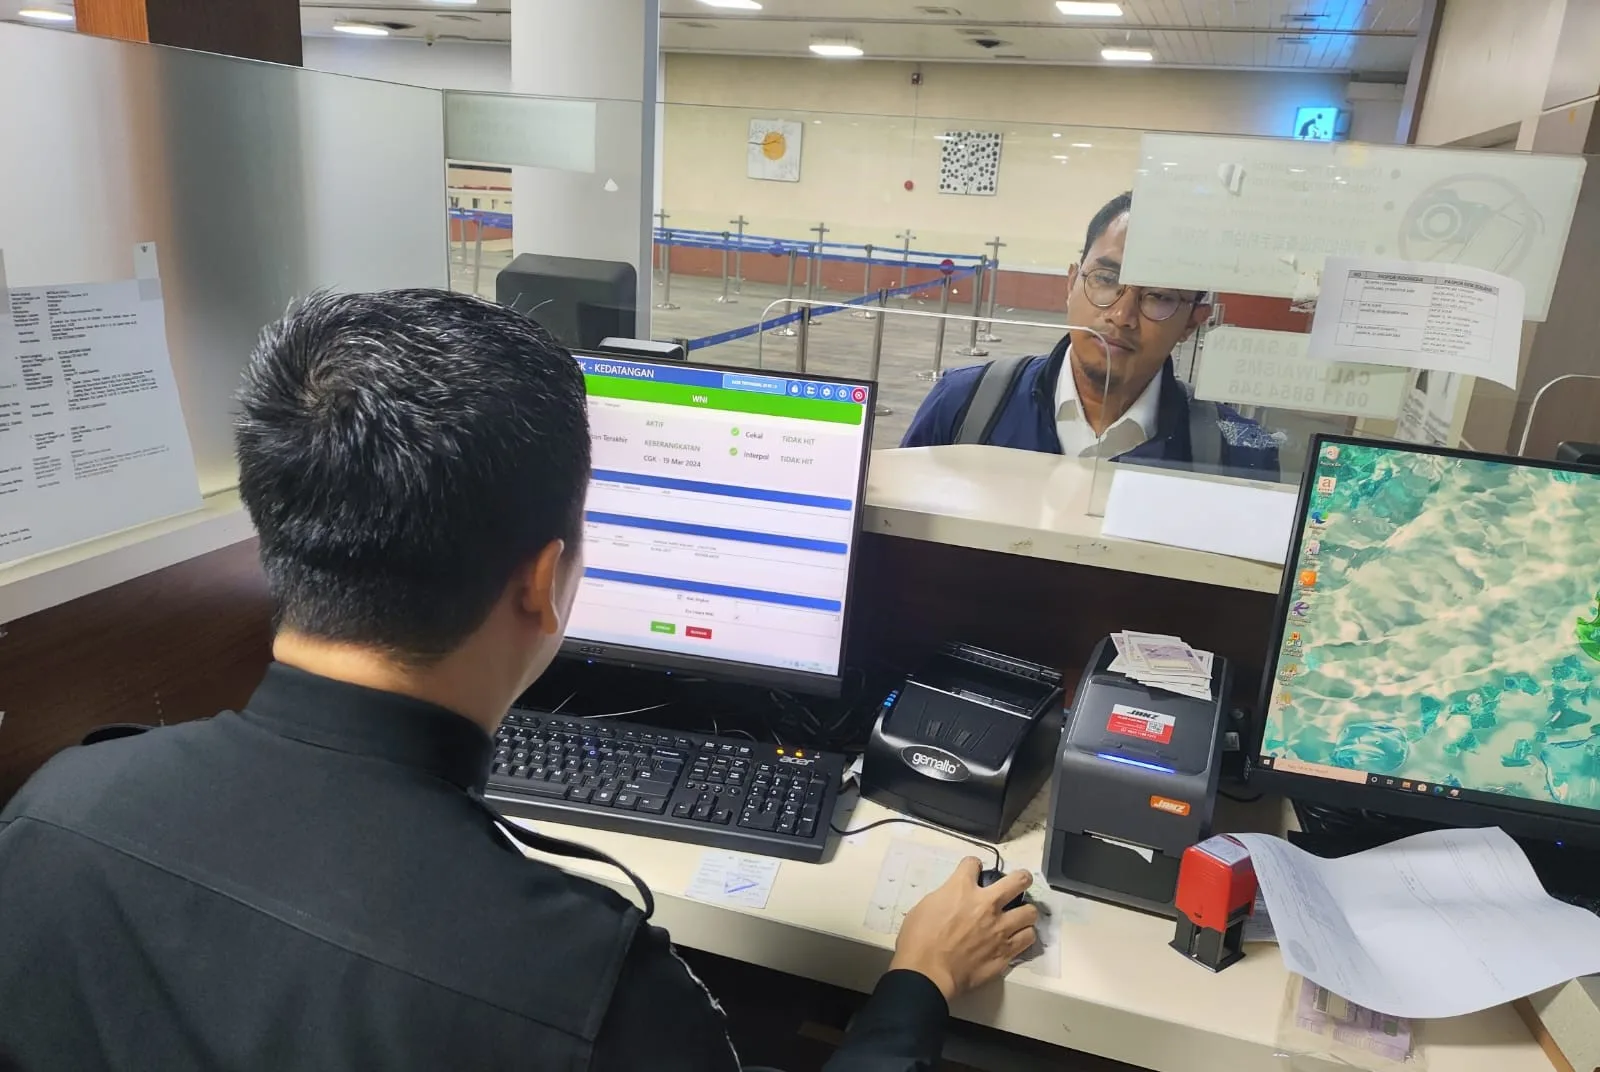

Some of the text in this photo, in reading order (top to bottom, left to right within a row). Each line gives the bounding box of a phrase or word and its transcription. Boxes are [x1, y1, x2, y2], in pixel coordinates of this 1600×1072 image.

[594, 363, 655, 378] KEDATANGAN
[692, 395, 708, 403] WNI
[645, 420, 665, 428] AKTIF
[603, 434, 628, 444] Terakhir
[745, 431, 816, 446] Cekal TIDAK HIT
[644, 439, 701, 452] KEBERANGKATAN
[643, 455, 657, 463] CGK
[671, 458, 685, 466] Mar
[686, 459, 701, 468] 2024
[780, 455, 801, 464] TIDAK
[779, 755, 815, 766] acer
[912, 750, 957, 775] gemalto
